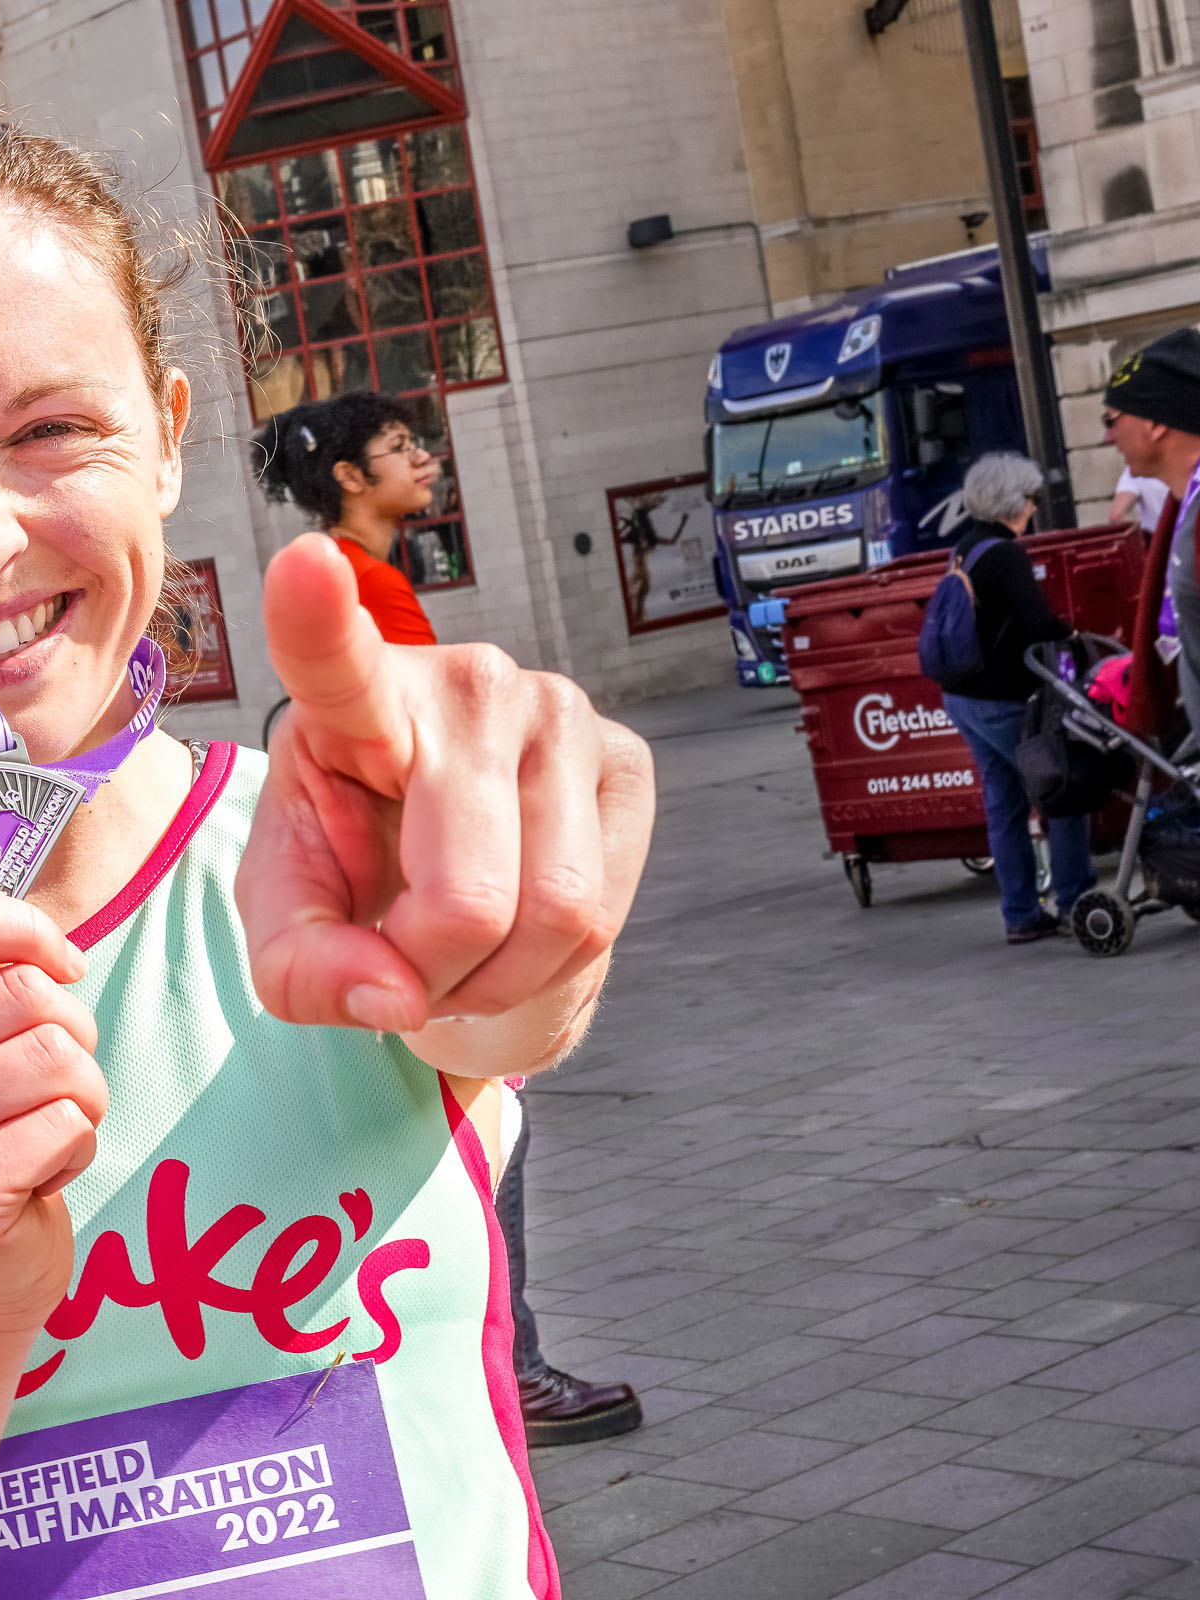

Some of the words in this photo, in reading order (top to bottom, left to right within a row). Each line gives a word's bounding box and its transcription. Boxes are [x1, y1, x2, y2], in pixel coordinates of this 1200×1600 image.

[733, 503, 854, 541] STARDES
[775, 553, 817, 570] DAF
[867, 776, 900, 795] 0114
[901, 774, 931, 792] 244
[932, 769, 974, 789] 5006
[3, 855, 27, 889] HALF
[20, 788, 67, 862] MARATHON
[16, 1157, 431, 1400] uke's
[70, 1450, 325, 1537] MARATHON
[214, 1492, 341, 1553] 2022
